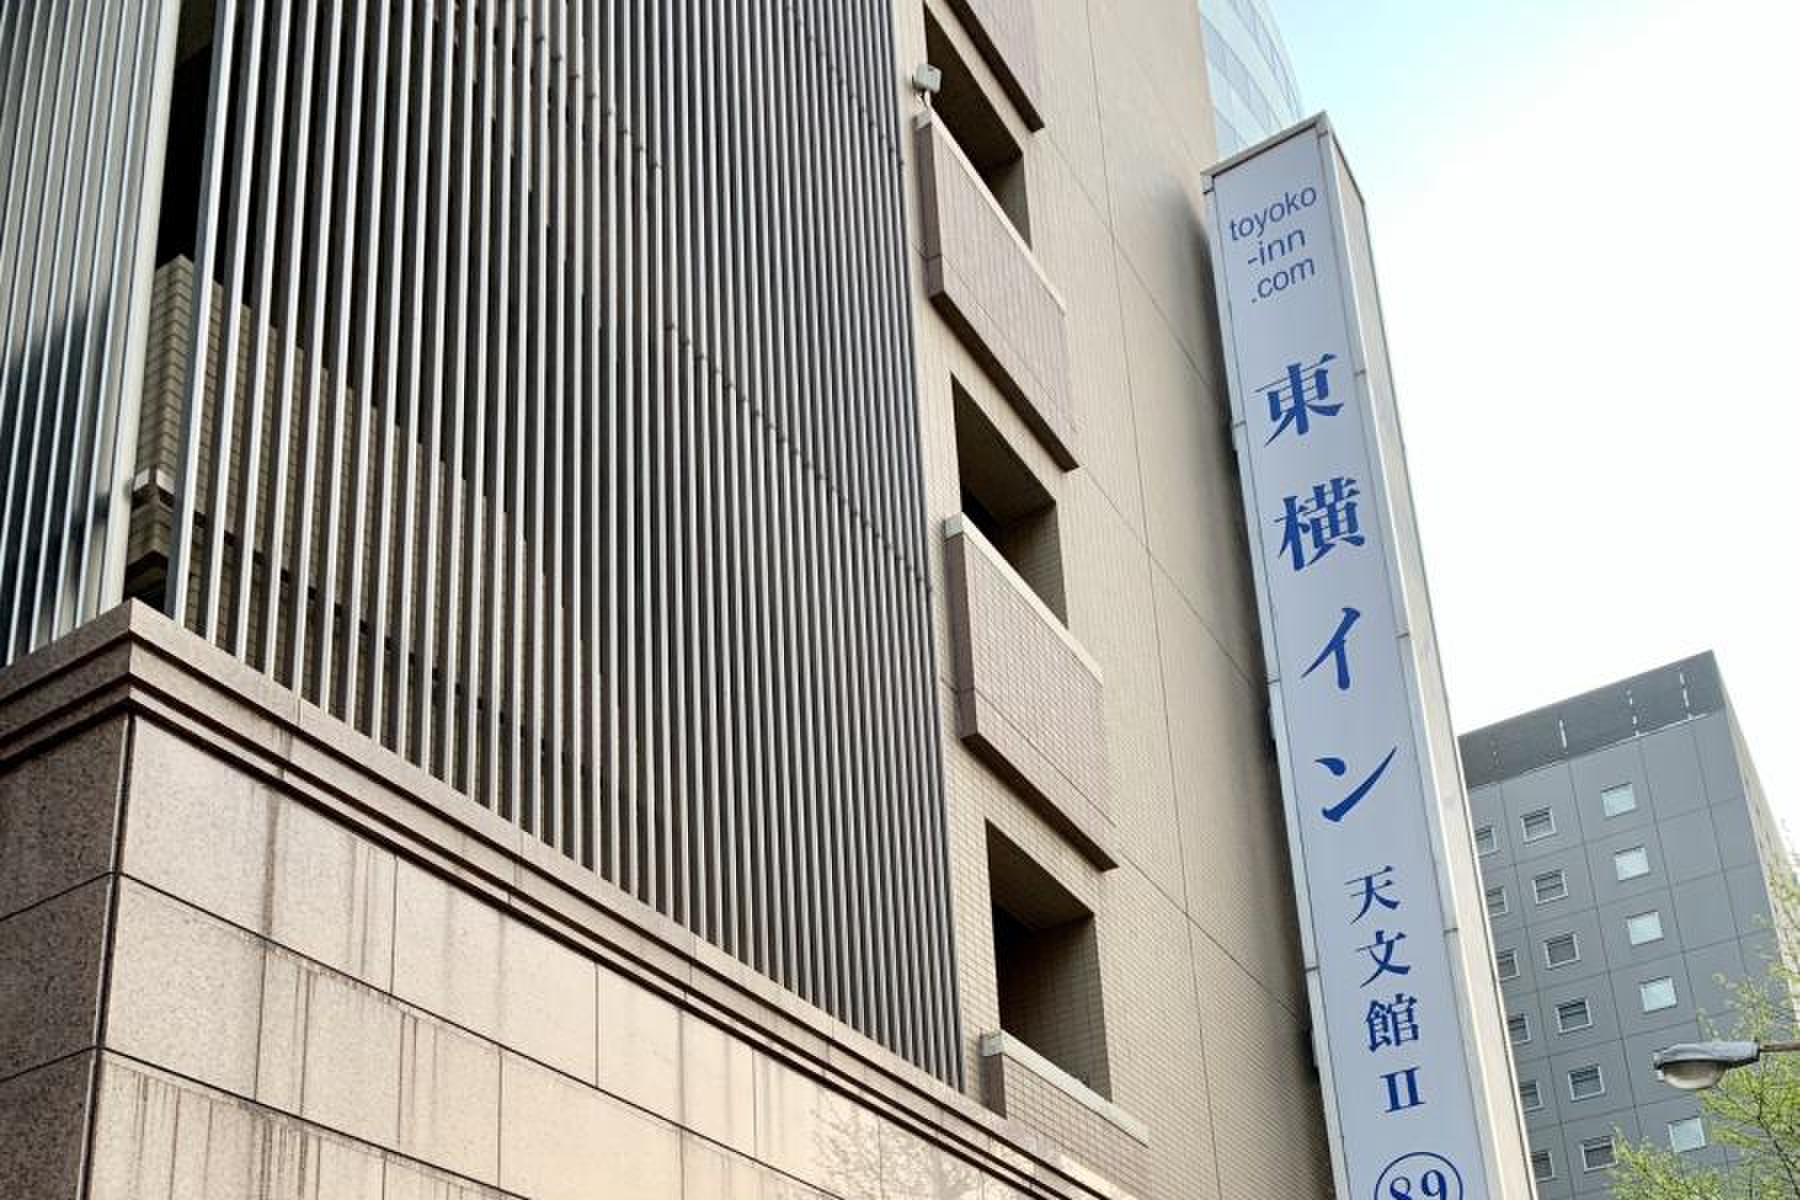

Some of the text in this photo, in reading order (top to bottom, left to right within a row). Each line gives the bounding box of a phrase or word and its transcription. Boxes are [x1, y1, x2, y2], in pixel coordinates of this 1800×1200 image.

[1229, 185, 1317, 241] toyoko
[1247, 227, 1306, 267] -inn
[1250, 256, 1315, 303] .com
